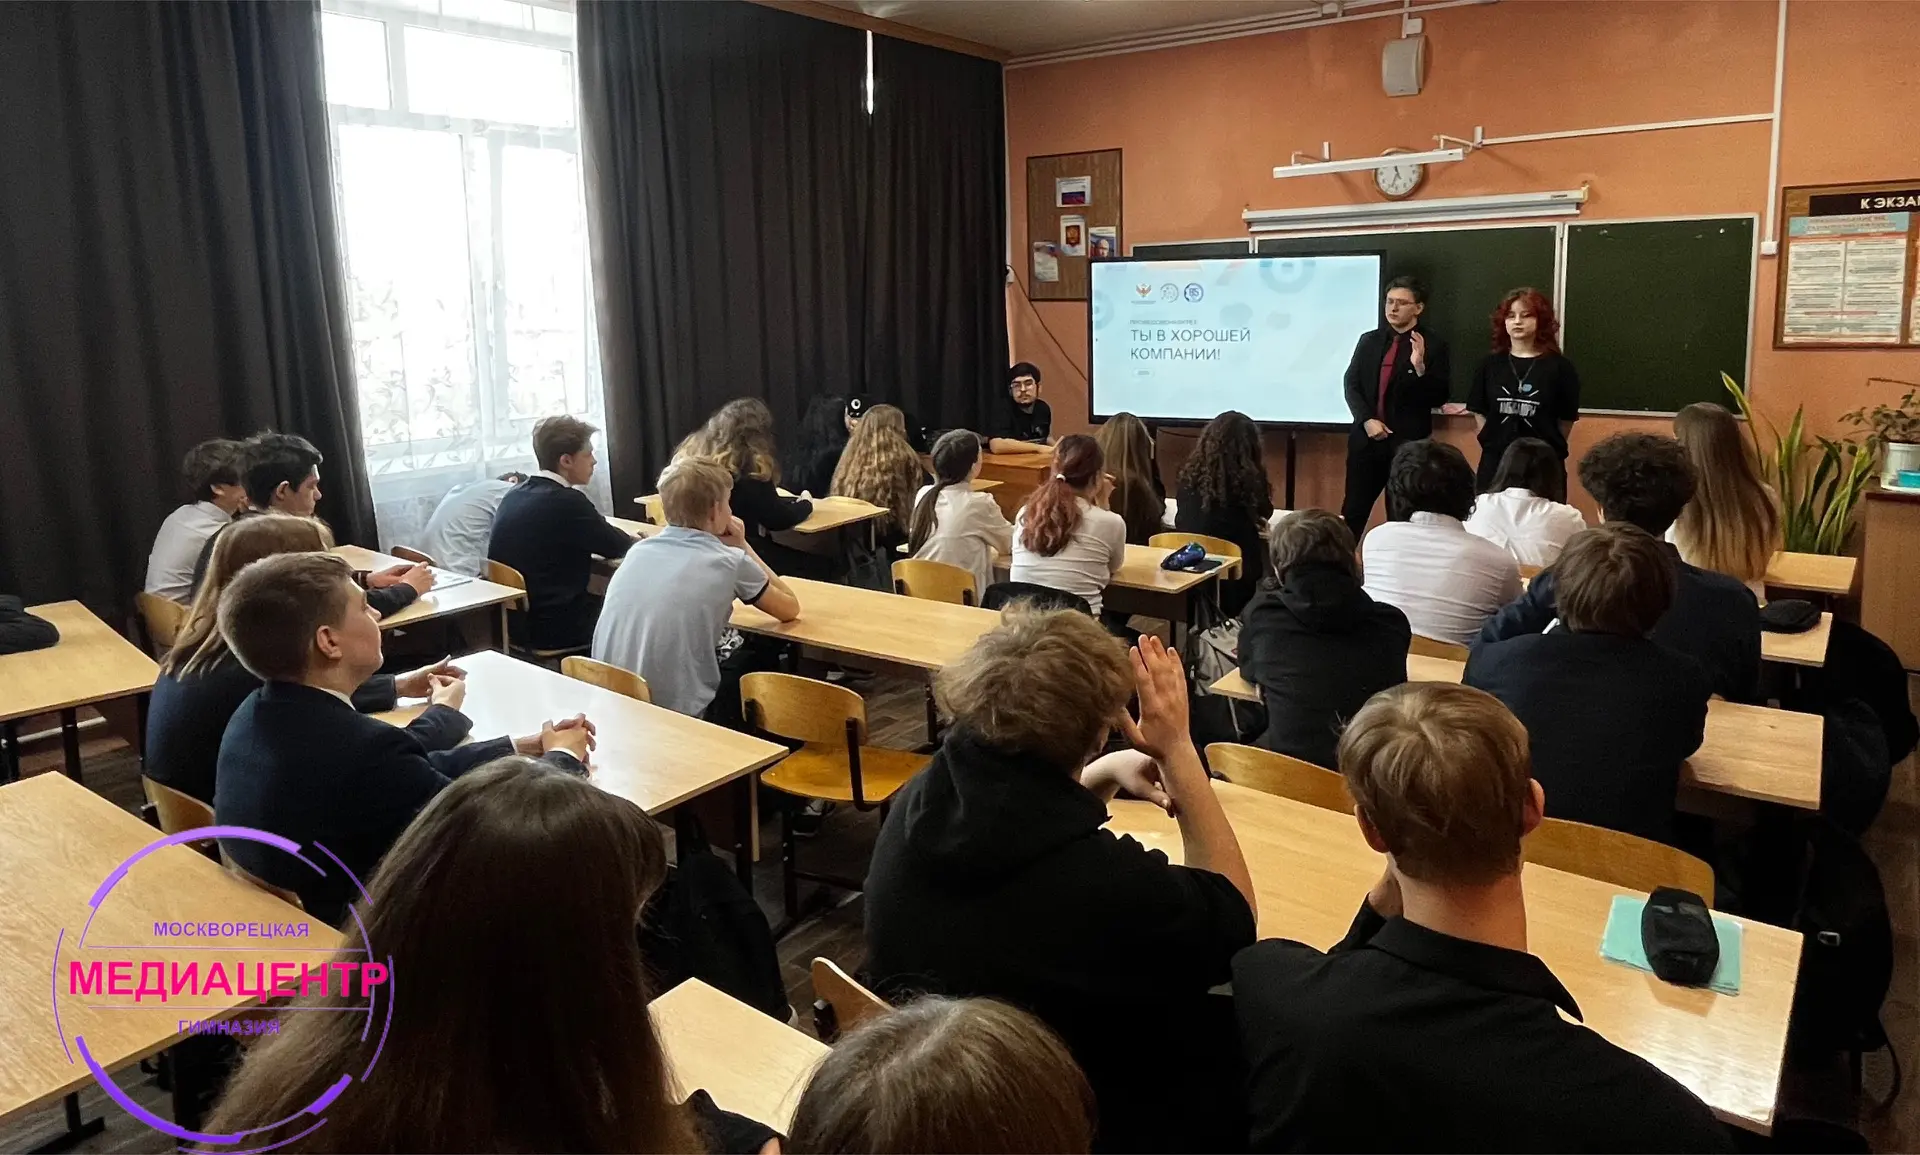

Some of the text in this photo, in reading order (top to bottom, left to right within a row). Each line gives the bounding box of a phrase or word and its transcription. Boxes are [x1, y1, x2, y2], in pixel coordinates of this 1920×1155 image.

[1861, 198, 1870, 210] К
[1130, 327, 1251, 342] ТЫ В ХОРОШЕЙ
[1130, 347, 1221, 360] КОМПАНИИ!
